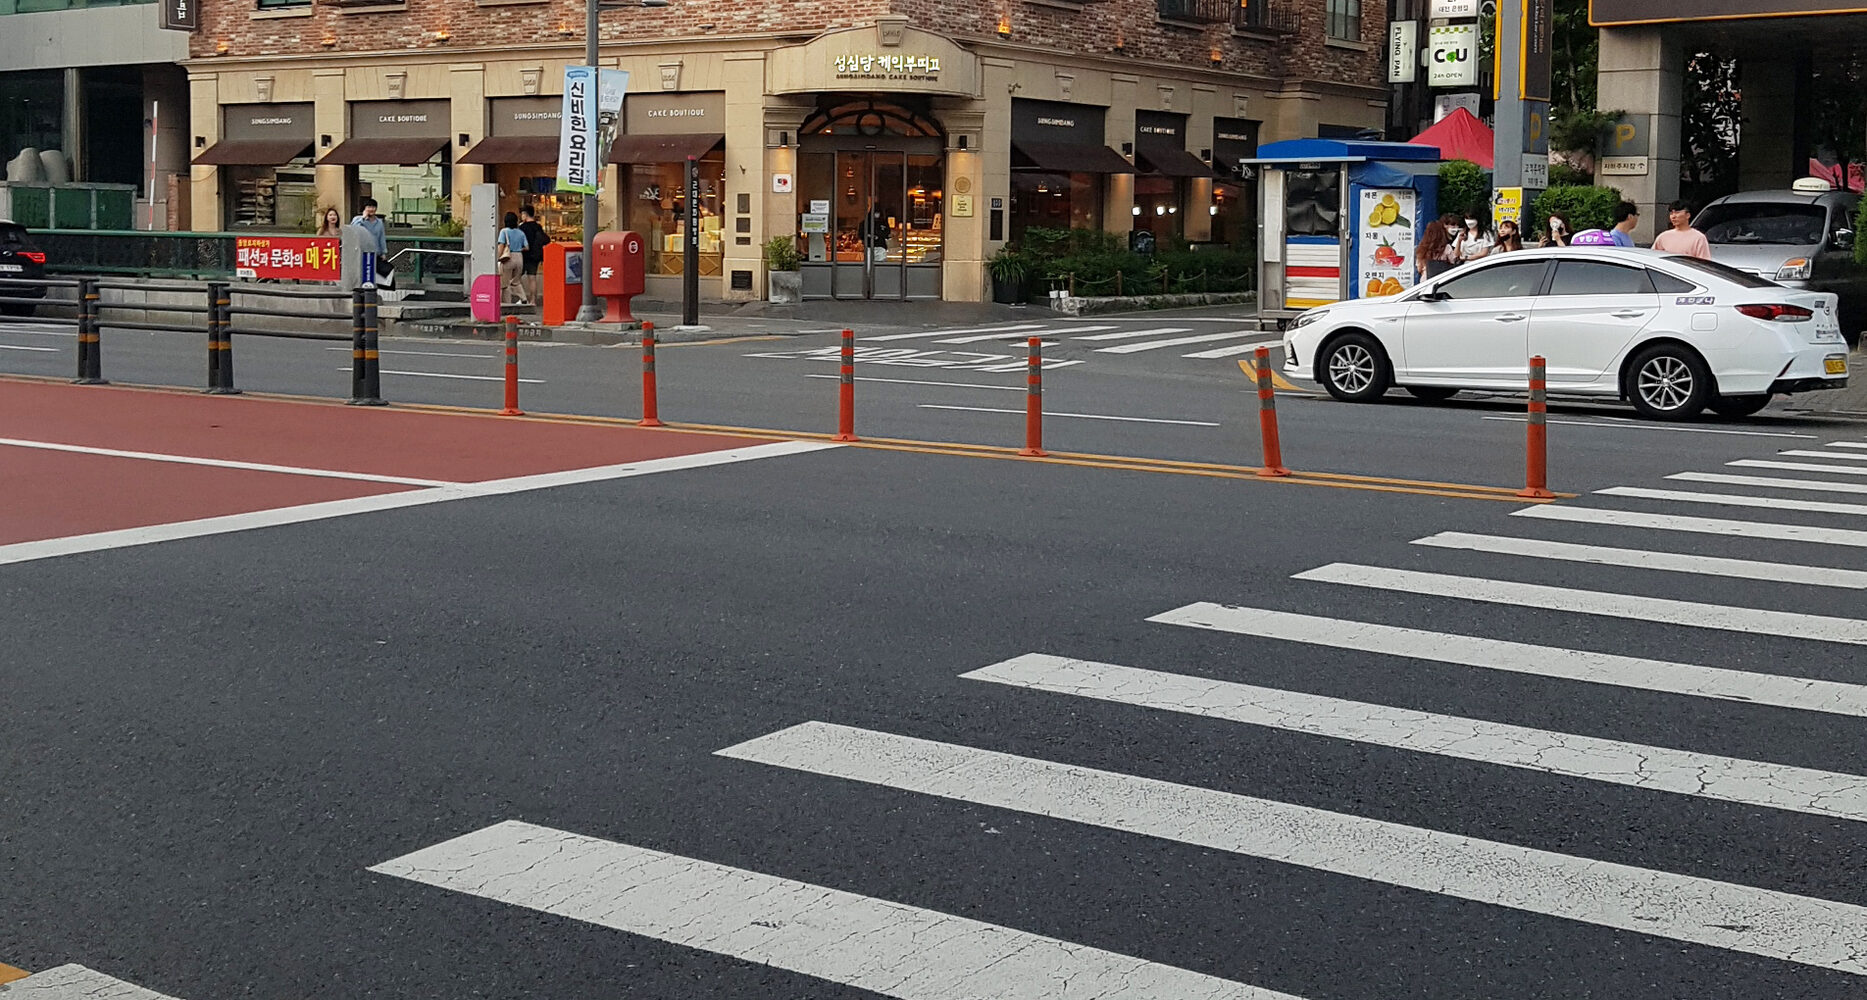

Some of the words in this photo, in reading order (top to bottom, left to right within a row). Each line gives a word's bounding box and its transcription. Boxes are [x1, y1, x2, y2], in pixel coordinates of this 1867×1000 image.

[1434, 47, 1468, 63] CU
[834, 54, 875, 73] 성심당
[379, 115, 397, 123] CAKE
[398, 114, 428, 123] BOUTIQUE
[648, 109, 668, 118] CAKE
[669, 108, 705, 117] BOUTIQUE
[1140, 126, 1152, 134] CAKE
[1530, 112, 1541, 152] P
[1615, 123, 1635, 149] P
[1603, 162, 1635, 171] 지하주차장
[1364, 191, 1377, 200] 레몬
[237, 248, 269, 268] 패션과
[270, 248, 304, 268] 문화의
[305, 246, 338, 271] 메카
